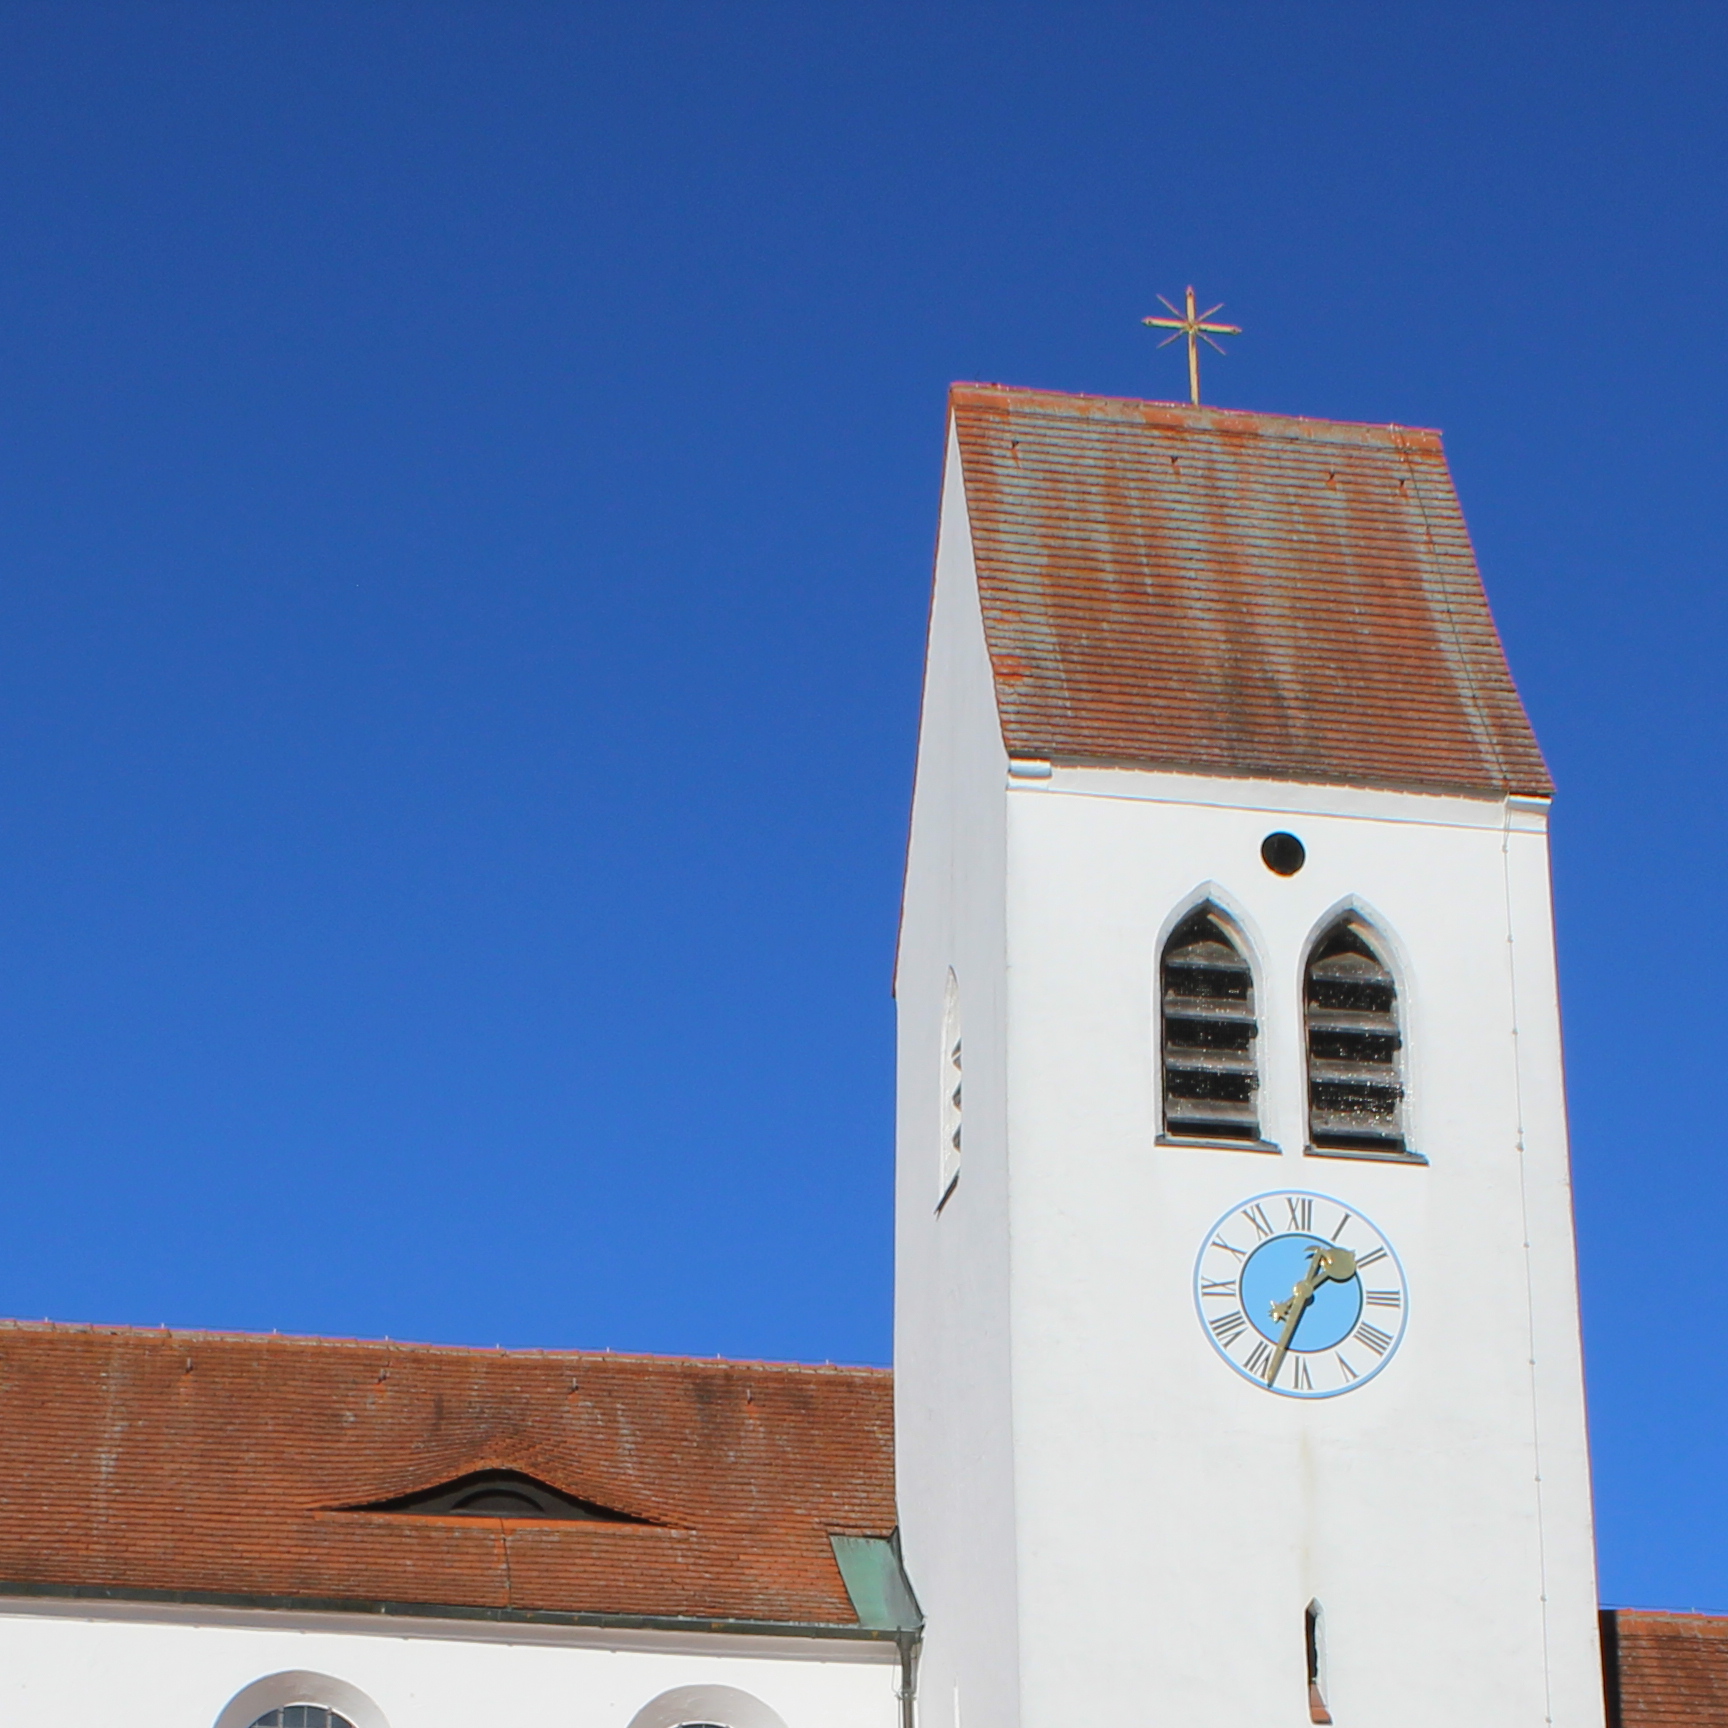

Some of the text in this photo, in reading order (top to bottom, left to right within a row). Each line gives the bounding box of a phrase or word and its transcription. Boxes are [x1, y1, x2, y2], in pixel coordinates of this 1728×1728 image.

[1240, 1203, 1275, 1242] XI
[1285, 1197, 1314, 1232] XII
[1210, 1233, 1248, 1264] X
[1201, 1275, 1237, 1297] IX
[1366, 1289, 1401, 1309] III
[1208, 1310, 1249, 1349] VIII
[1292, 1355, 1315, 1390] VI
[1334, 1350, 1360, 1383] V
